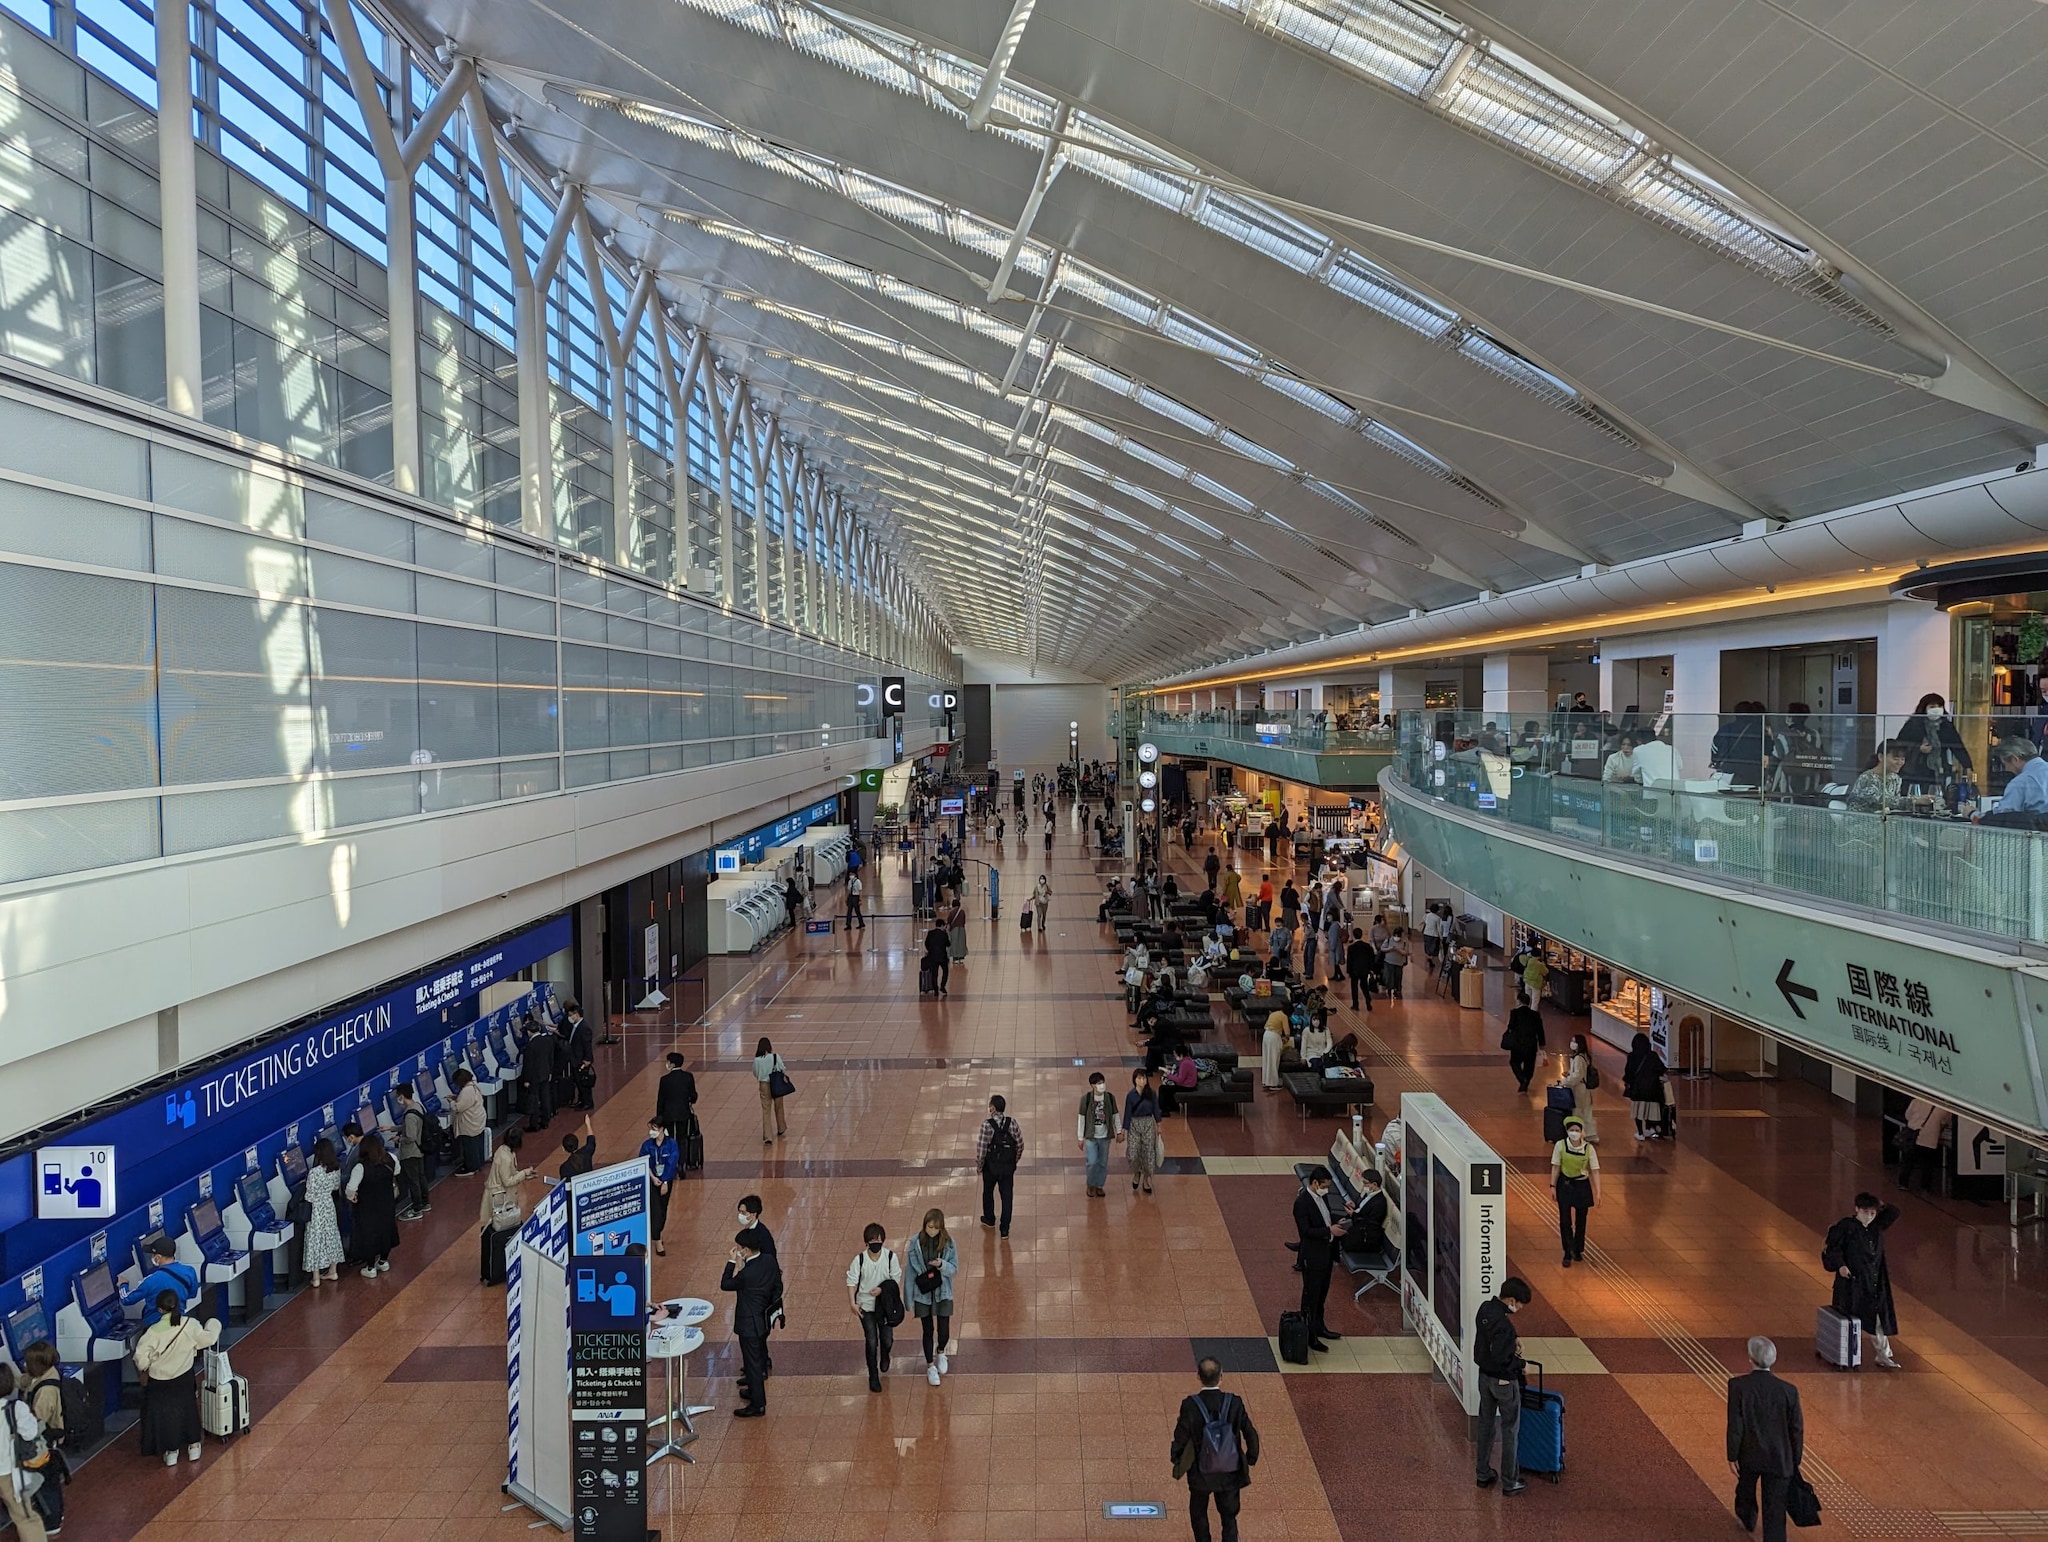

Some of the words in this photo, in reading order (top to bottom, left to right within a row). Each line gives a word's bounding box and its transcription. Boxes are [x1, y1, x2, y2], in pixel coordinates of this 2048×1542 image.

[884, 684, 902, 706] C
[944, 694, 957, 708] D
[1144, 746, 1152, 760] 5
[866, 774, 876, 787] C
[892, 769, 899, 778] C
[1846, 962, 1934, 1018] 国際線
[416, 997, 438, 1015] Ticketing
[441, 990, 456, 1003] Check
[1837, 997, 1960, 1055] INTERNATIONAL
[1852, 1024, 1892, 1054] 国际线
[1907, 1043, 1953, 1076] 국제선
[200, 1042, 301, 1117] TICKETING
[305, 1036, 319, 1068] &
[321, 1009, 374, 1059] CHECK
[375, 1001, 392, 1034] IN
[89, 1151, 106, 1164] 10
[581, 1167, 640, 1190] ANAからのお知らせ
[1480, 1204, 1495, 1295] Information
[575, 1333, 641, 1347] TICKETING
[627, 1348, 641, 1360] IN
[576, 1366, 642, 1377] 購入・搭乗手続き
[576, 1380, 607, 1389] Ticketing
[614, 1380, 634, 1388] Check
[597, 1411, 614, 1419] ANA
